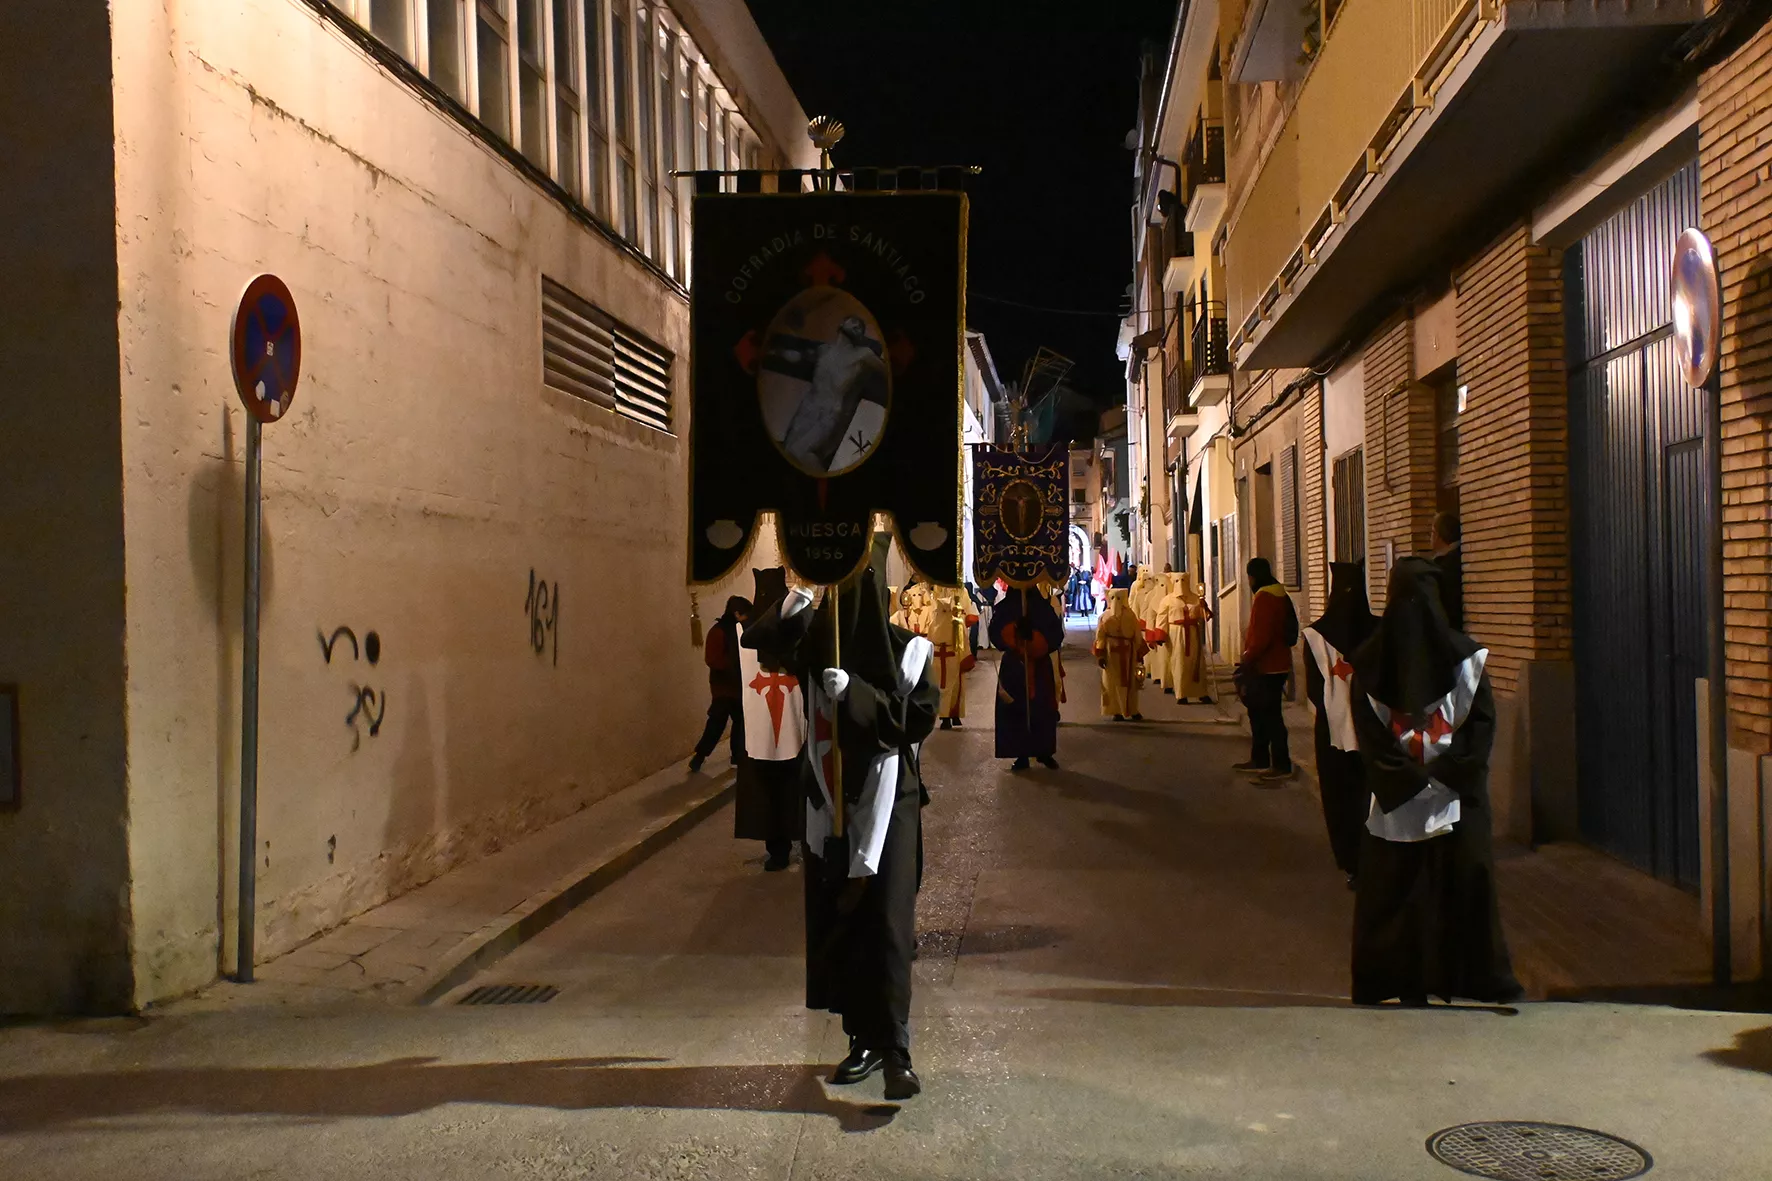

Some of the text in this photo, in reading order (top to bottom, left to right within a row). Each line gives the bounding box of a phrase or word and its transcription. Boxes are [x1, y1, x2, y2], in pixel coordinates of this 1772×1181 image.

[725, 223, 926, 305] COFRADIA DE SANTIAGO
[790, 522, 862, 538] HUESCA
[804, 546, 844, 560] 1956
